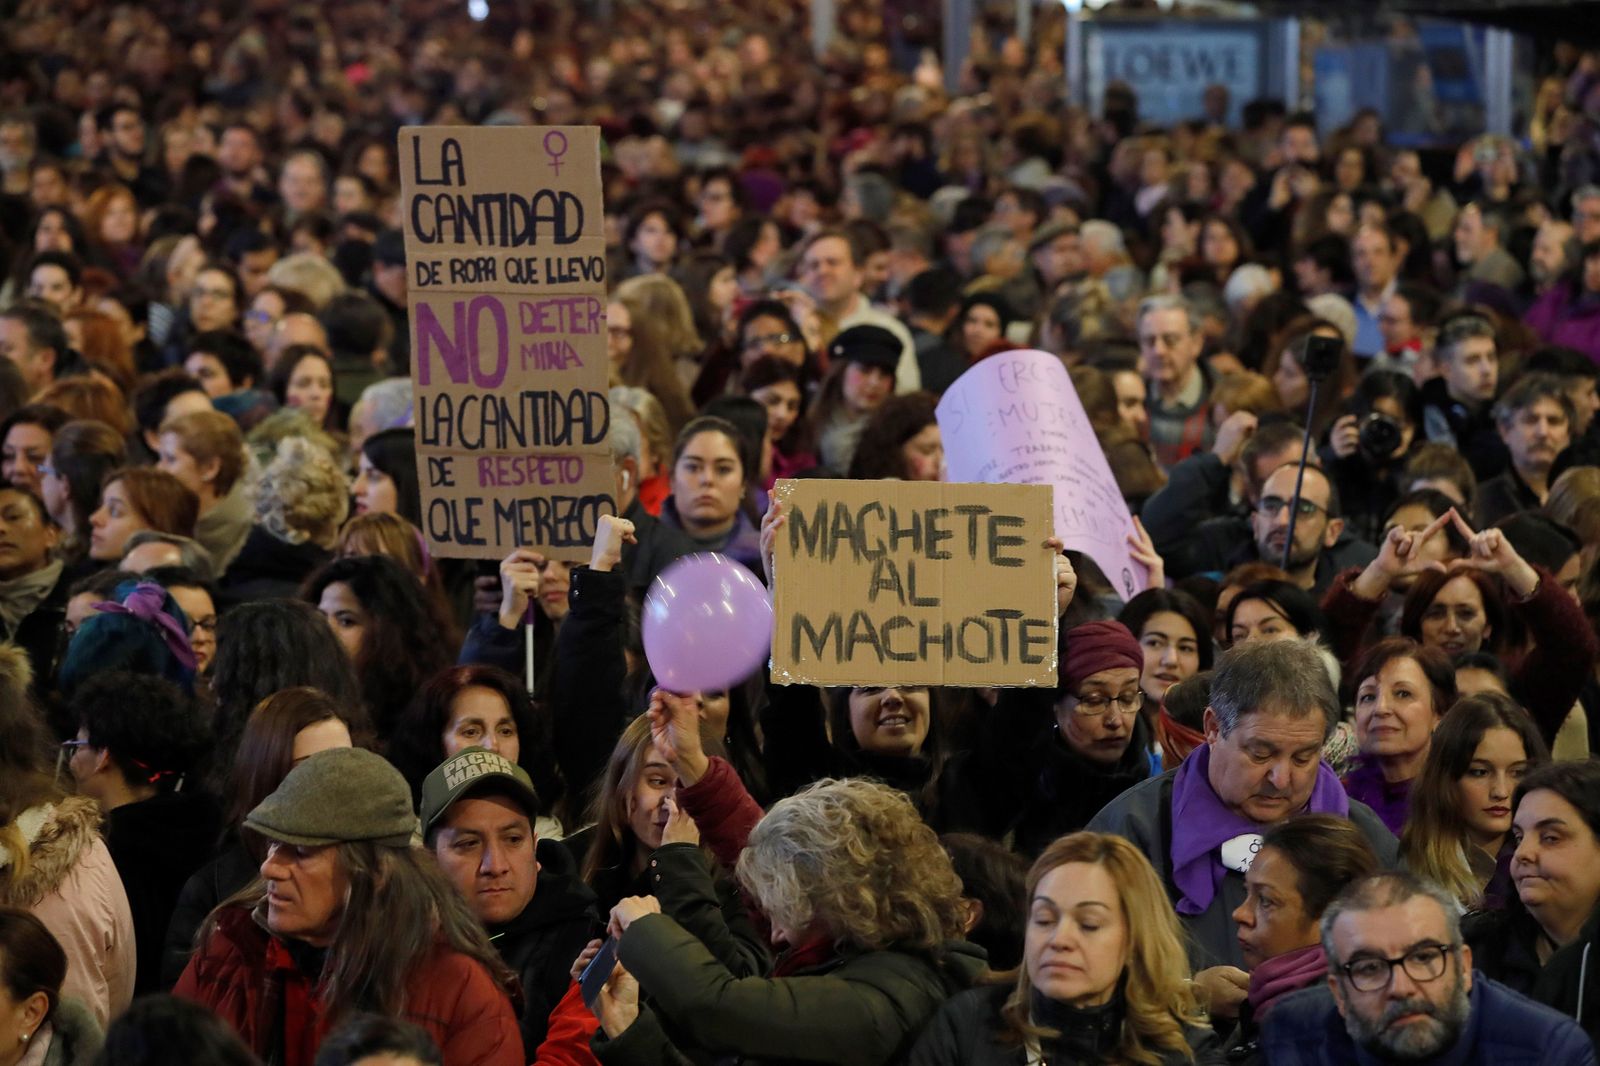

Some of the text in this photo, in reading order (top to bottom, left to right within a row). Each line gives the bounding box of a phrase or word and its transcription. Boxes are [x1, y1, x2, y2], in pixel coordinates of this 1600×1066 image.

[412, 135, 466, 187] LA
[411, 189, 584, 248] CANTIDAD
[416, 256, 605, 287] DE ROPA QUE LLEVO
[415, 294, 607, 389] NO DETER-
[520, 340, 584, 371] MINA
[420, 389, 610, 450] LA CANTIDAD
[428, 456, 584, 487] DE RESPETO
[428, 498, 487, 545] QUE
[789, 500, 1027, 567] MACHETE
[868, 558, 940, 607] AL
[791, 609, 1050, 665] MACHOTE
[443, 752, 513, 778] PACHA
